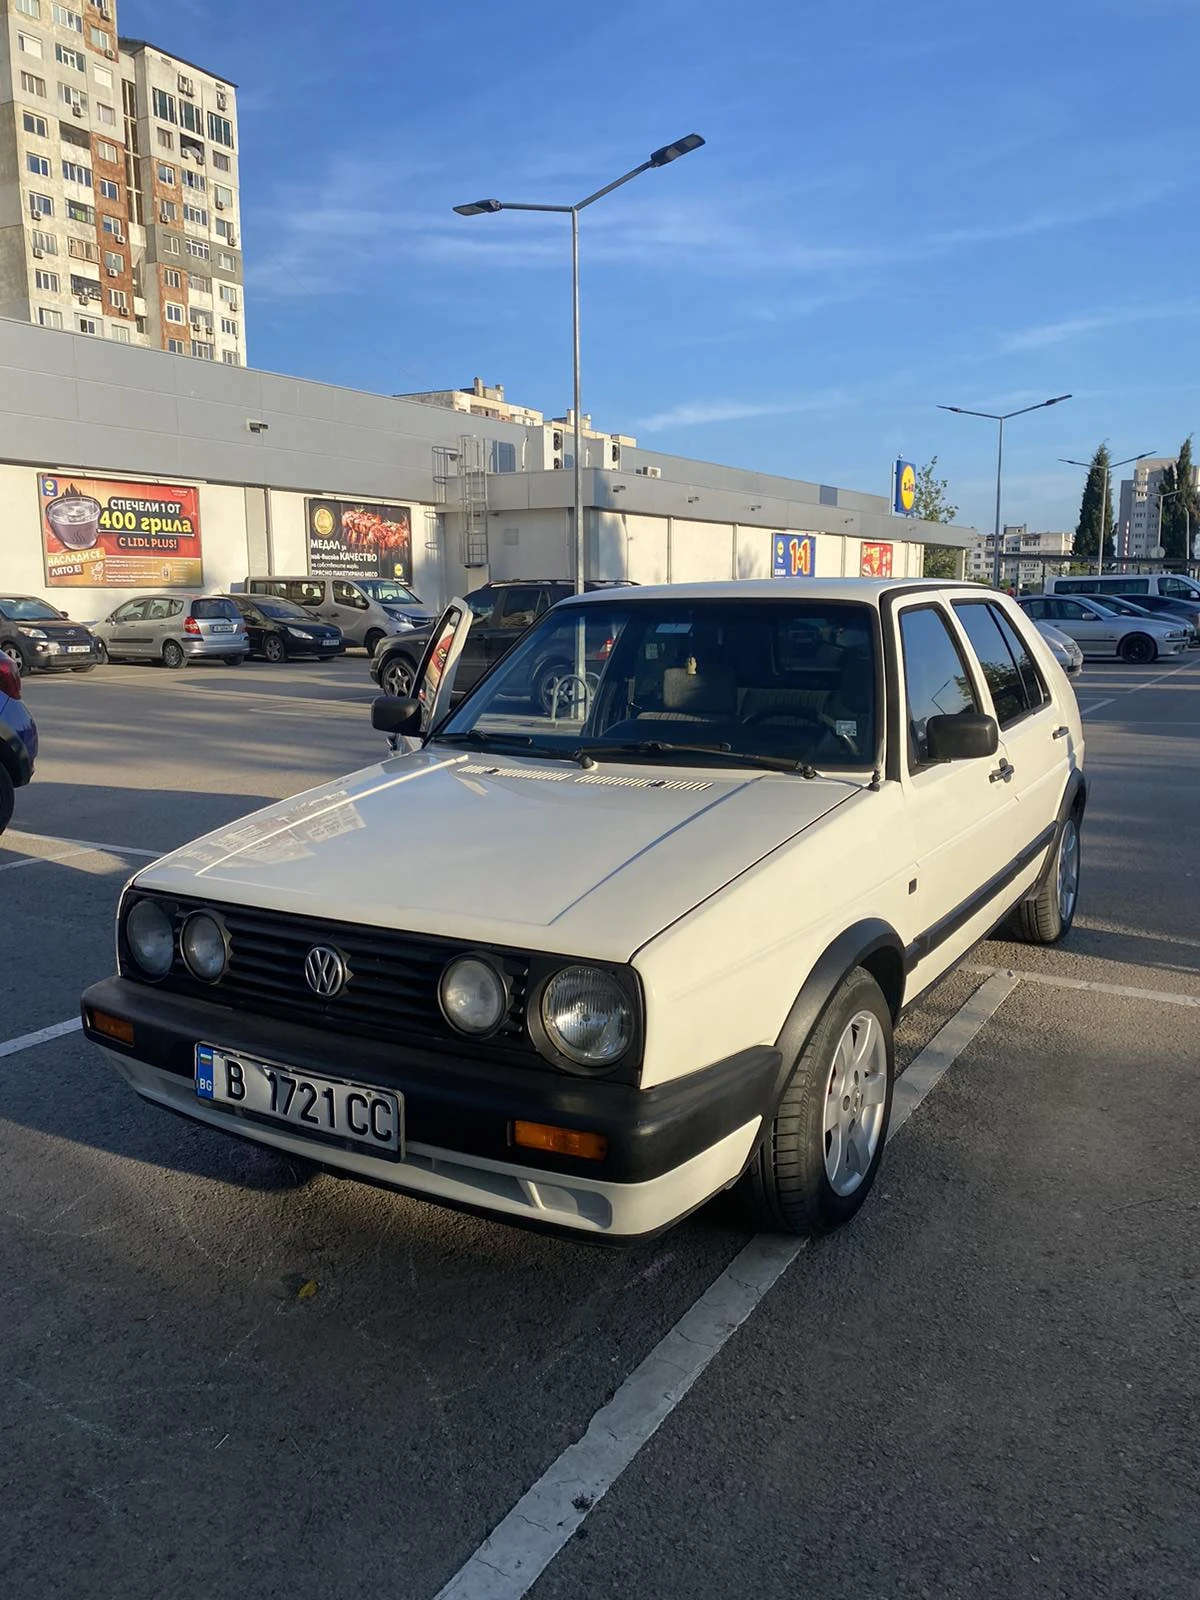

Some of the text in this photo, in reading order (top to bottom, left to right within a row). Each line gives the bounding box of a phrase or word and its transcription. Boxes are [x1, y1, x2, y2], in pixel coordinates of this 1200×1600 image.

[110, 499, 181, 514] СПЕЧЕЛИ 1 ОТ
[99, 510, 192, 534] 400 грила
[119, 537, 177, 549] С LIDL PLUS!
[310, 539, 340, 551] МЕДАЛ
[48, 552, 89, 565] НАСЛАДИ
[340, 552, 378, 562] КАЧЕСТВО
[51, 565, 74, 577] ЛЯТО
[305, 947, 342, 996] VW
[198, 1078, 213, 1092] BG
[226, 1060, 393, 1142] B 1721 CC
